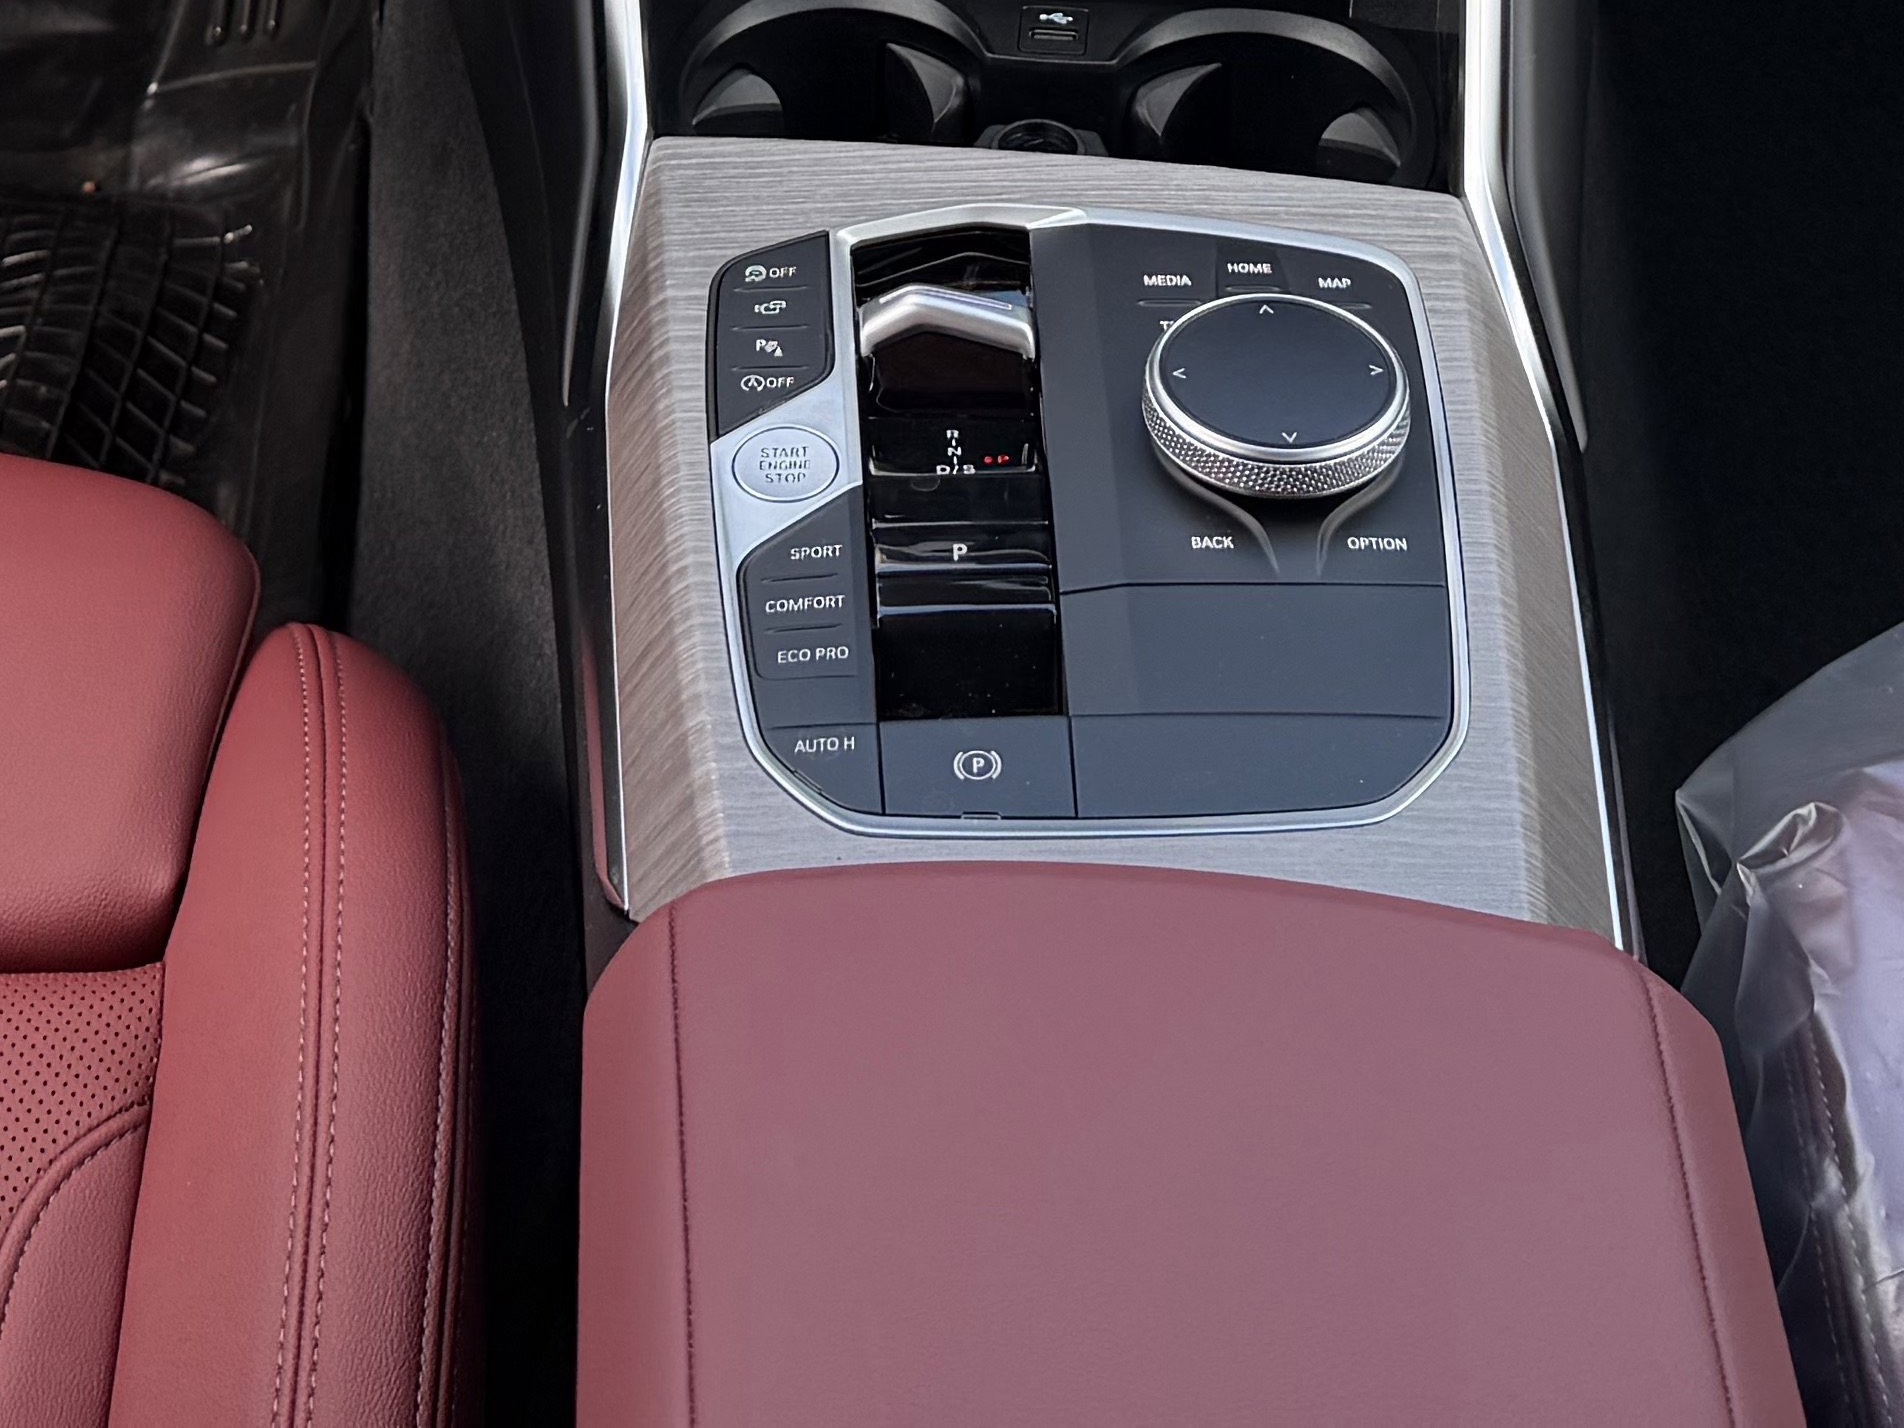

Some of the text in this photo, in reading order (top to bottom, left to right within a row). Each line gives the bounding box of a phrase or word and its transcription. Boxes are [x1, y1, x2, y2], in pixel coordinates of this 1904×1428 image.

[769, 266, 797, 278] OFF
[1226, 262, 1273, 274] HOME
[1143, 274, 1192, 287] MEDIA
[1317, 277, 1352, 289] MAP
[766, 376, 795, 389] OFF
[760, 446, 810, 458] START
[759, 459, 811, 471] ENGINE
[764, 472, 807, 484] STOP
[1190, 535, 1235, 549] BACK
[1347, 536, 1408, 551] OPTION
[790, 544, 843, 560] SPORT
[952, 543, 968, 561] P
[765, 594, 846, 613] COMFORT
[777, 646, 849, 664] ECO PRO
[794, 736, 855, 753] AUTO H
